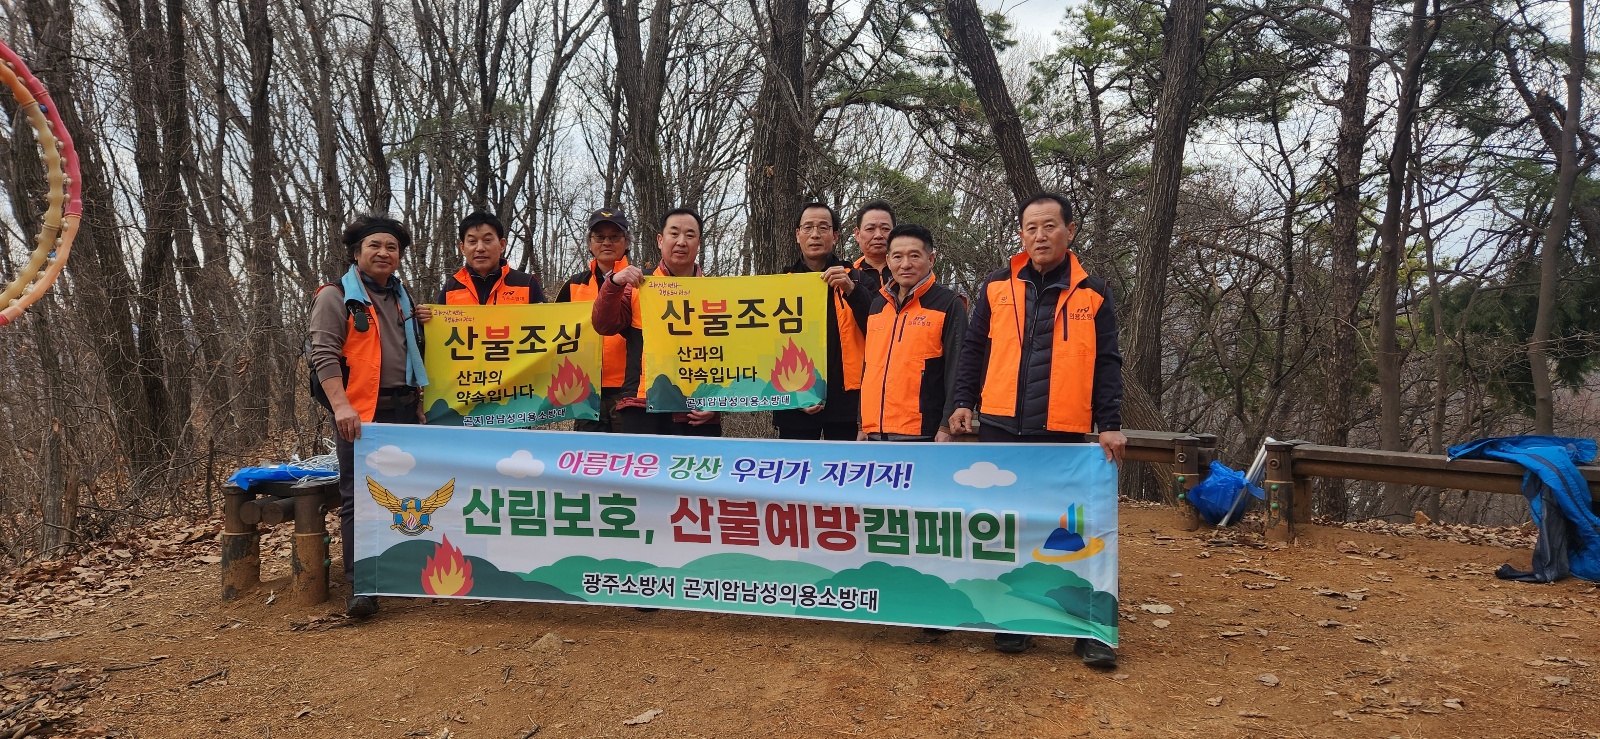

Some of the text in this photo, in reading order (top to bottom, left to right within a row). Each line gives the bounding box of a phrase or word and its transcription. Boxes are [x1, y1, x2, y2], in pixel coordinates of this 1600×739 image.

[660, 296, 803, 337] 산불조심
[444, 322, 582, 362] 산불조심
[677, 345, 724, 363] 산과의
[456, 369, 503, 386] 산과의
[678, 365, 758, 384] 약속입니다
[456, 383, 535, 406] 약속입니다
[686, 395, 791, 410] 곤지암남성의용소방대
[463, 407, 567, 427] 곤지암남성의용소방대
[558, 450, 914, 489] 아름다운 강산 우리가 지키자!
[462, 488, 1017, 564] 산림보호, 산불예방캠페인
[582, 572, 879, 612] 광주소방서 곤지암남성의용소방대
